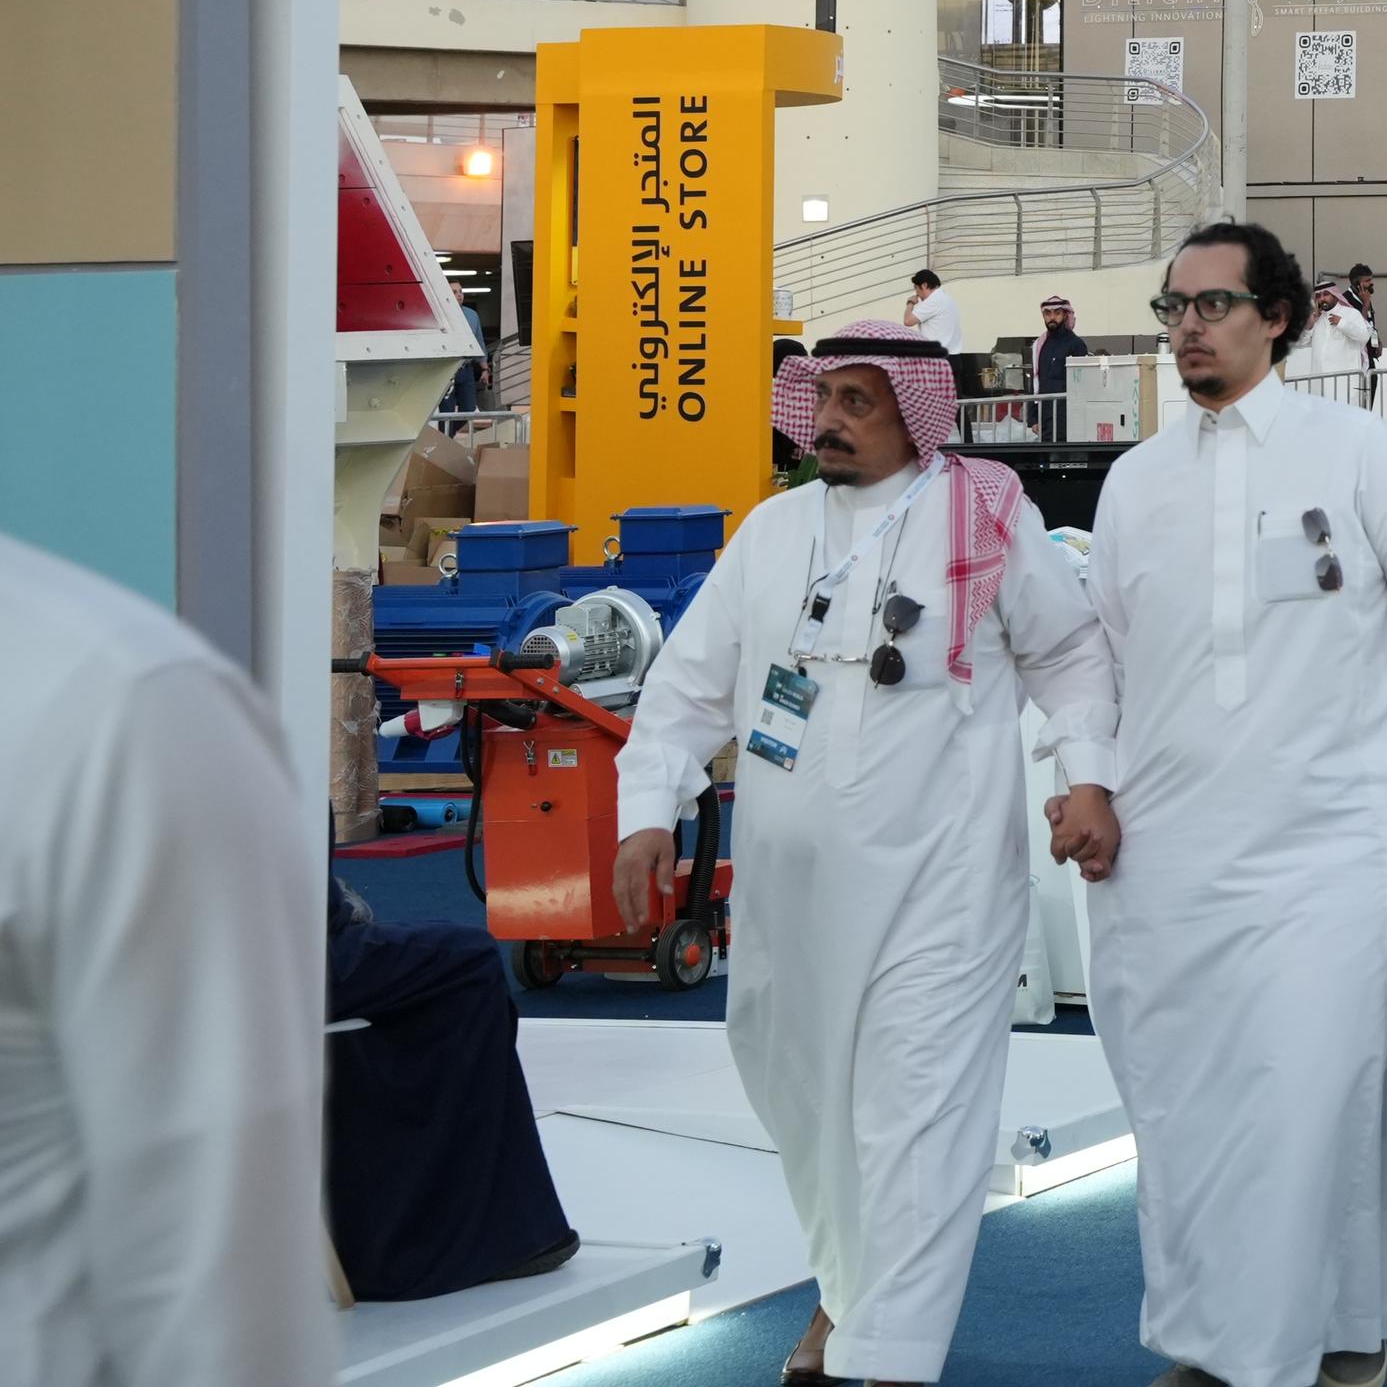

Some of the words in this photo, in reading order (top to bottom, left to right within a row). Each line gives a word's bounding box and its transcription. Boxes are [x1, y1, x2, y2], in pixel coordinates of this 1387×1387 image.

[1083, 12, 1147, 24] LIGHTNING
[631, 96, 671, 214] المتجر
[679, 94, 709, 230] STORE
[631, 225, 671, 420] الإلكتروني
[677, 258, 708, 423] ONLINE
